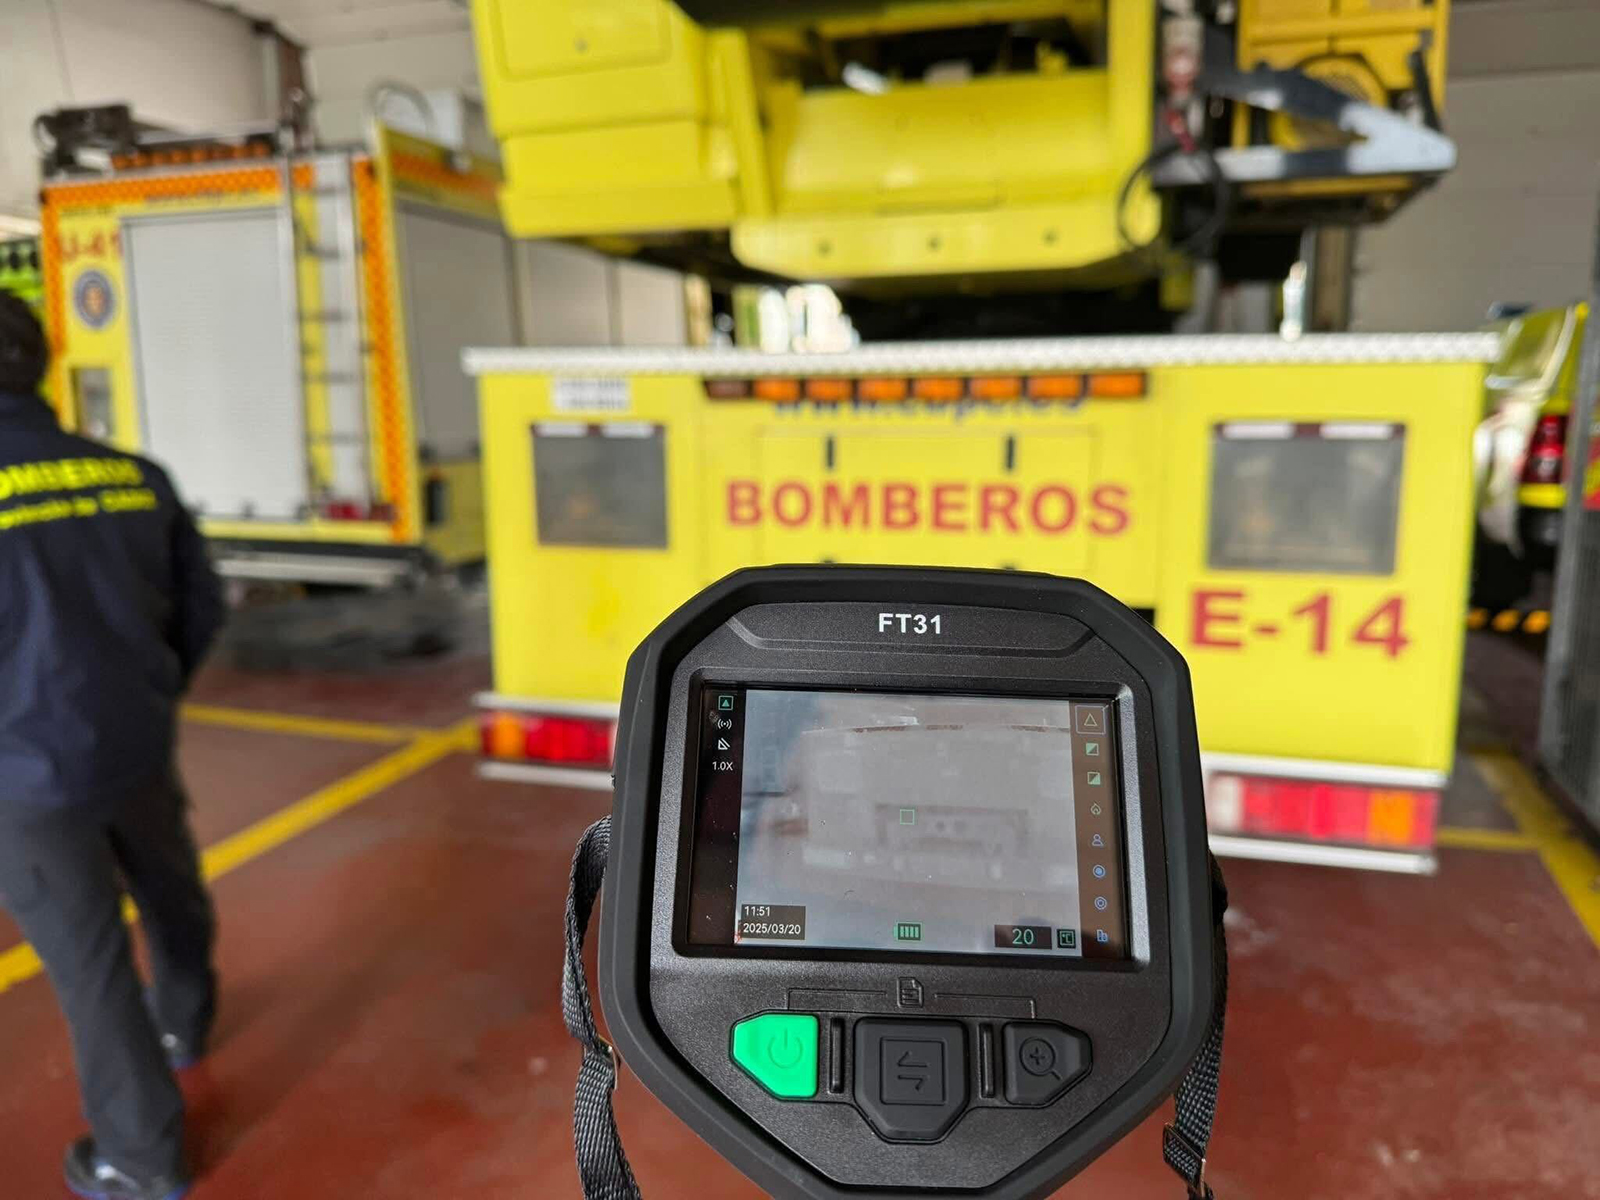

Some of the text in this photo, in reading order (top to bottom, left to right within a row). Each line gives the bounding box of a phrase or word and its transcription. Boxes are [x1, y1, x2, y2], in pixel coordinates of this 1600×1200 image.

[726, 480, 1132, 537] BOMBEROS
[878, 612, 941, 635] FT31
[1189, 588, 1410, 660] E-14
[712, 761, 733, 771] 1.0X
[744, 905, 771, 917] 11:51
[743, 922, 801, 935] 2025/03/20
[1012, 928, 1034, 945] 20
